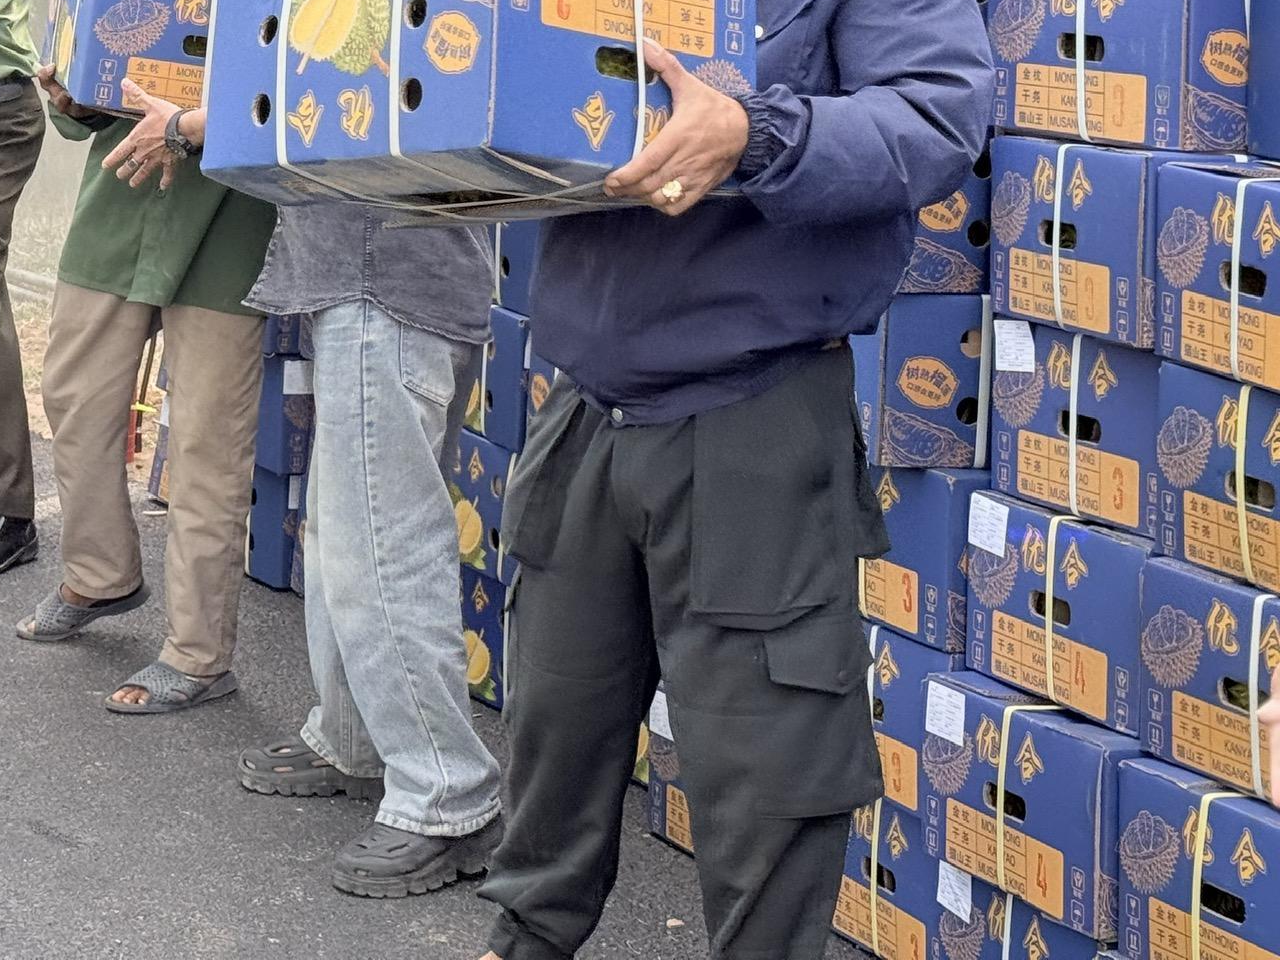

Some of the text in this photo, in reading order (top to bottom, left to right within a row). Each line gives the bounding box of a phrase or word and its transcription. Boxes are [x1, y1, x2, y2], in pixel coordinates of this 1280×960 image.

[1033, 155, 1092, 211] 优合
[1047, 340, 1119, 402] 优合
[1022, 523, 1089, 589] 优合
[976, 713, 1045, 785] 优合
